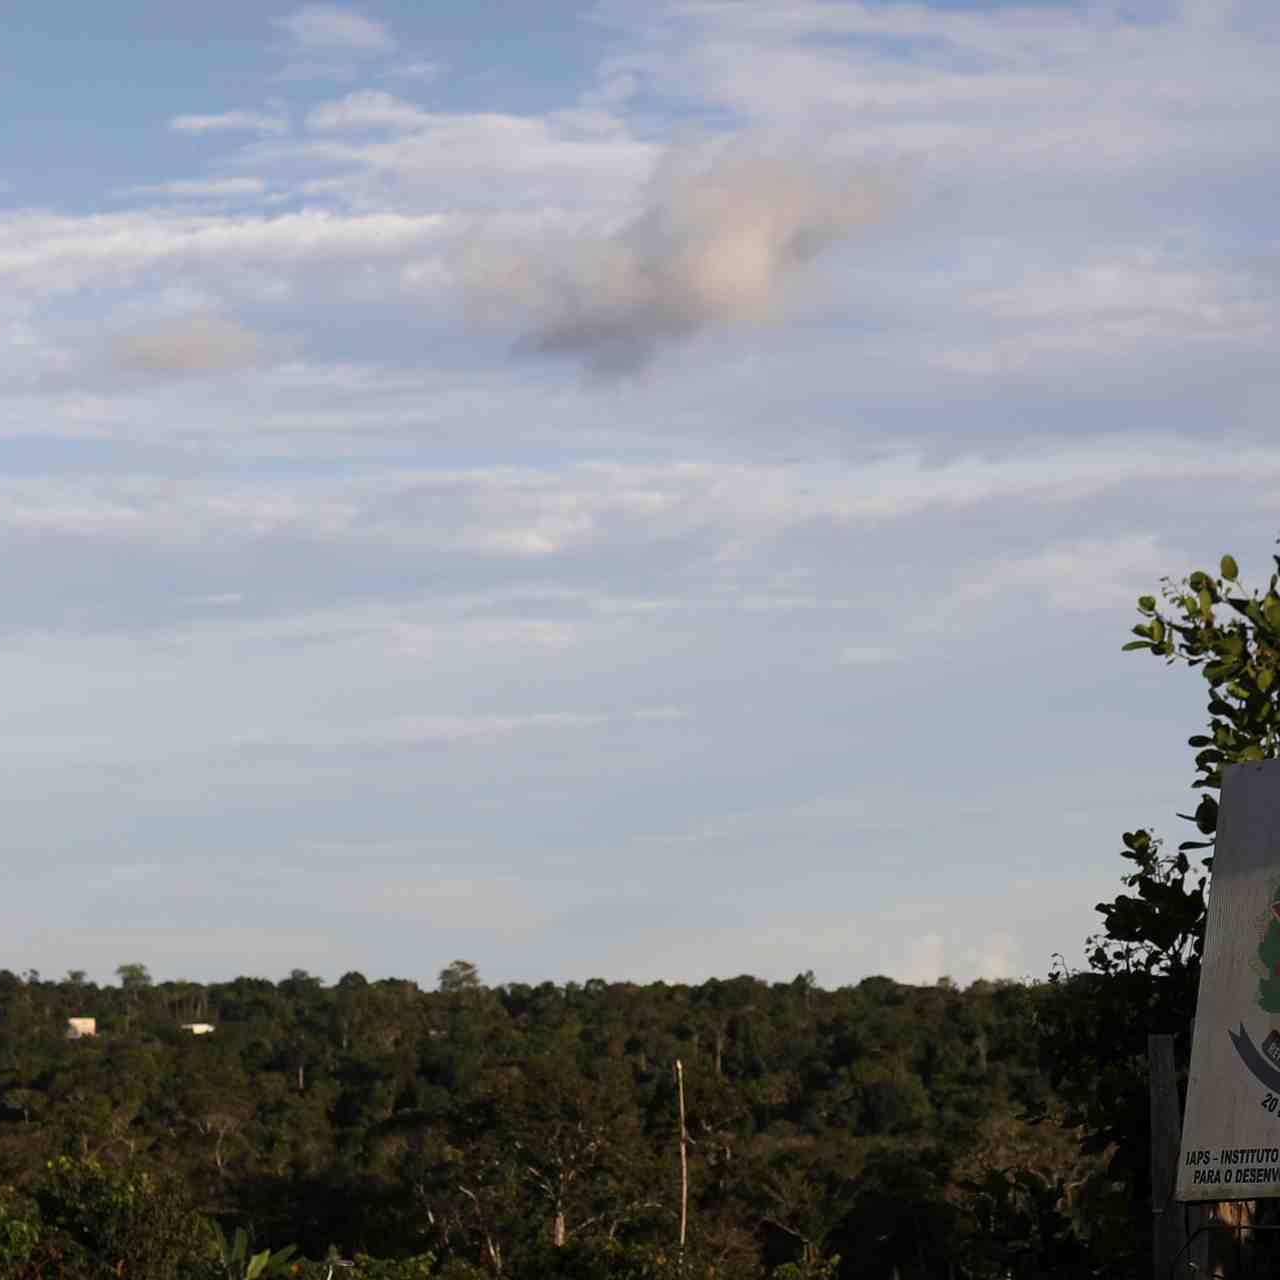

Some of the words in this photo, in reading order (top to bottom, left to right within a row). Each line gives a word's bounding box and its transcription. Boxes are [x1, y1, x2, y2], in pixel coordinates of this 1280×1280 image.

[1262, 1093, 1277, 1112] 20
[1186, 1151, 1210, 1165] IAPS
[1221, 1148, 1278, 1164] INSTITUTO
[1194, 1170, 1221, 1184] PARA
[1224, 1170, 1232, 1183] O
